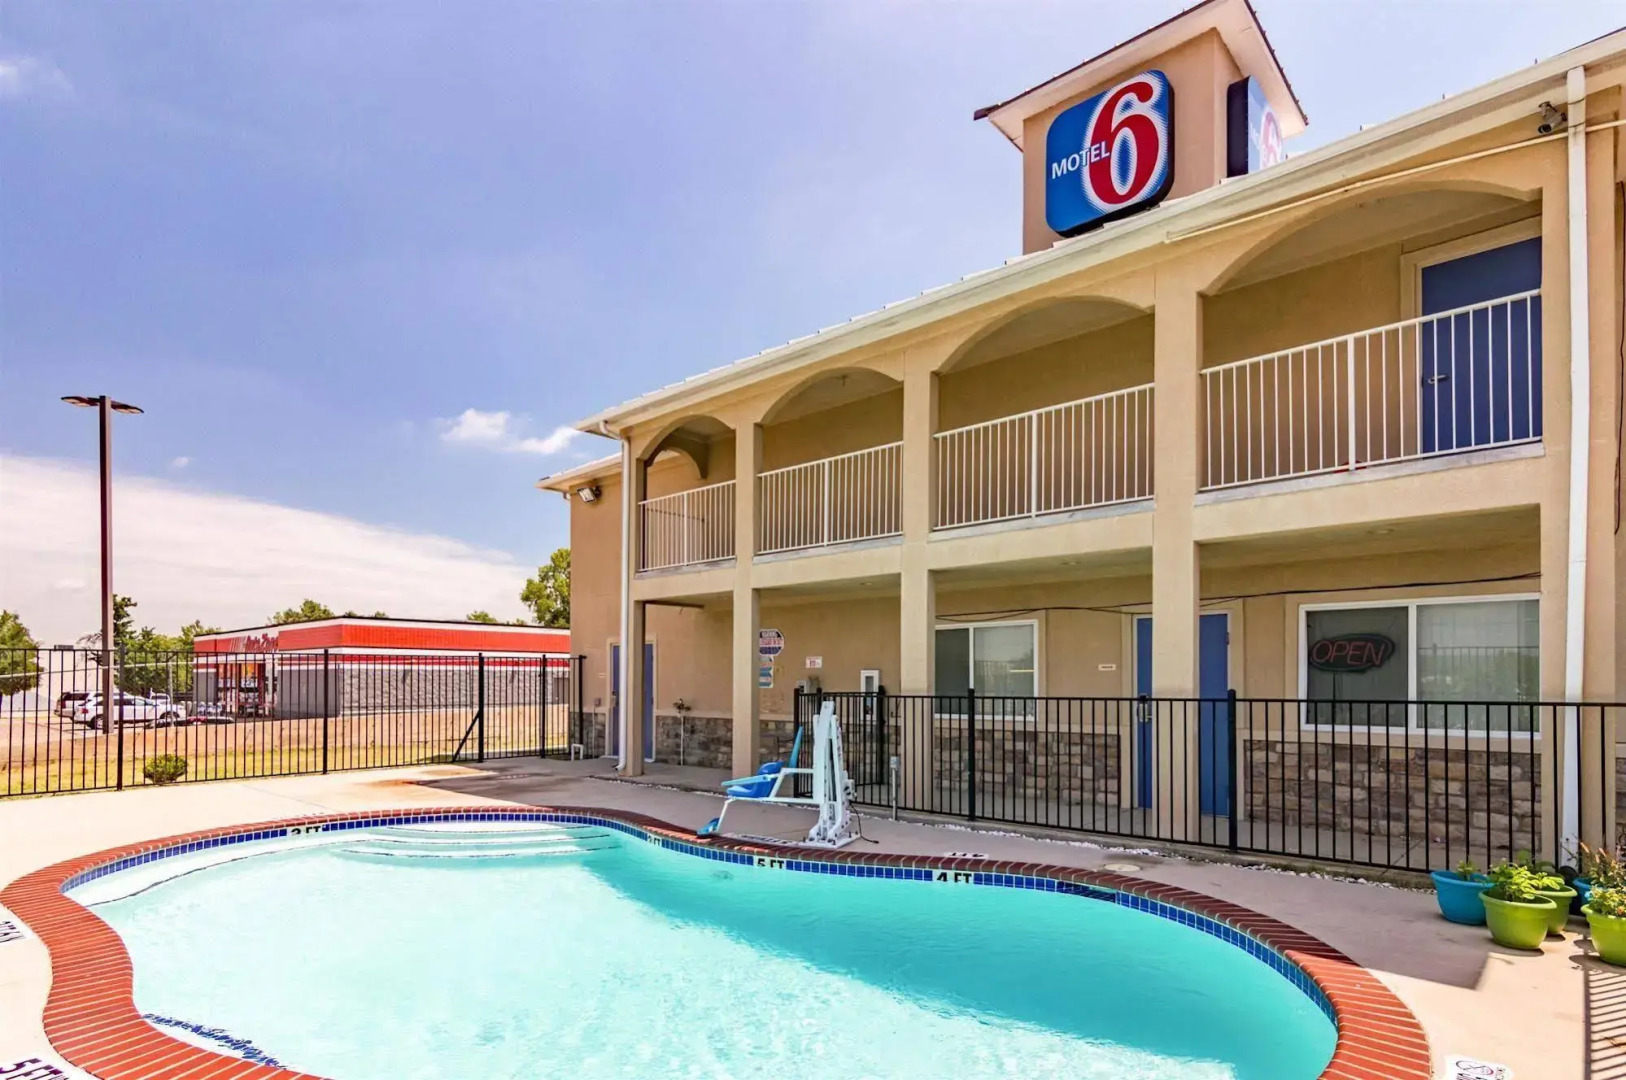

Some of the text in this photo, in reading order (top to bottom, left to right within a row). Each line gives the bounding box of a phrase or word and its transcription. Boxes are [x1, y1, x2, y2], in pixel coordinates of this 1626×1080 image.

[1051, 81, 1160, 205] MOTEL 6
[1312, 640, 1385, 666] OPEN
[936, 871, 972, 883] 4 FT
